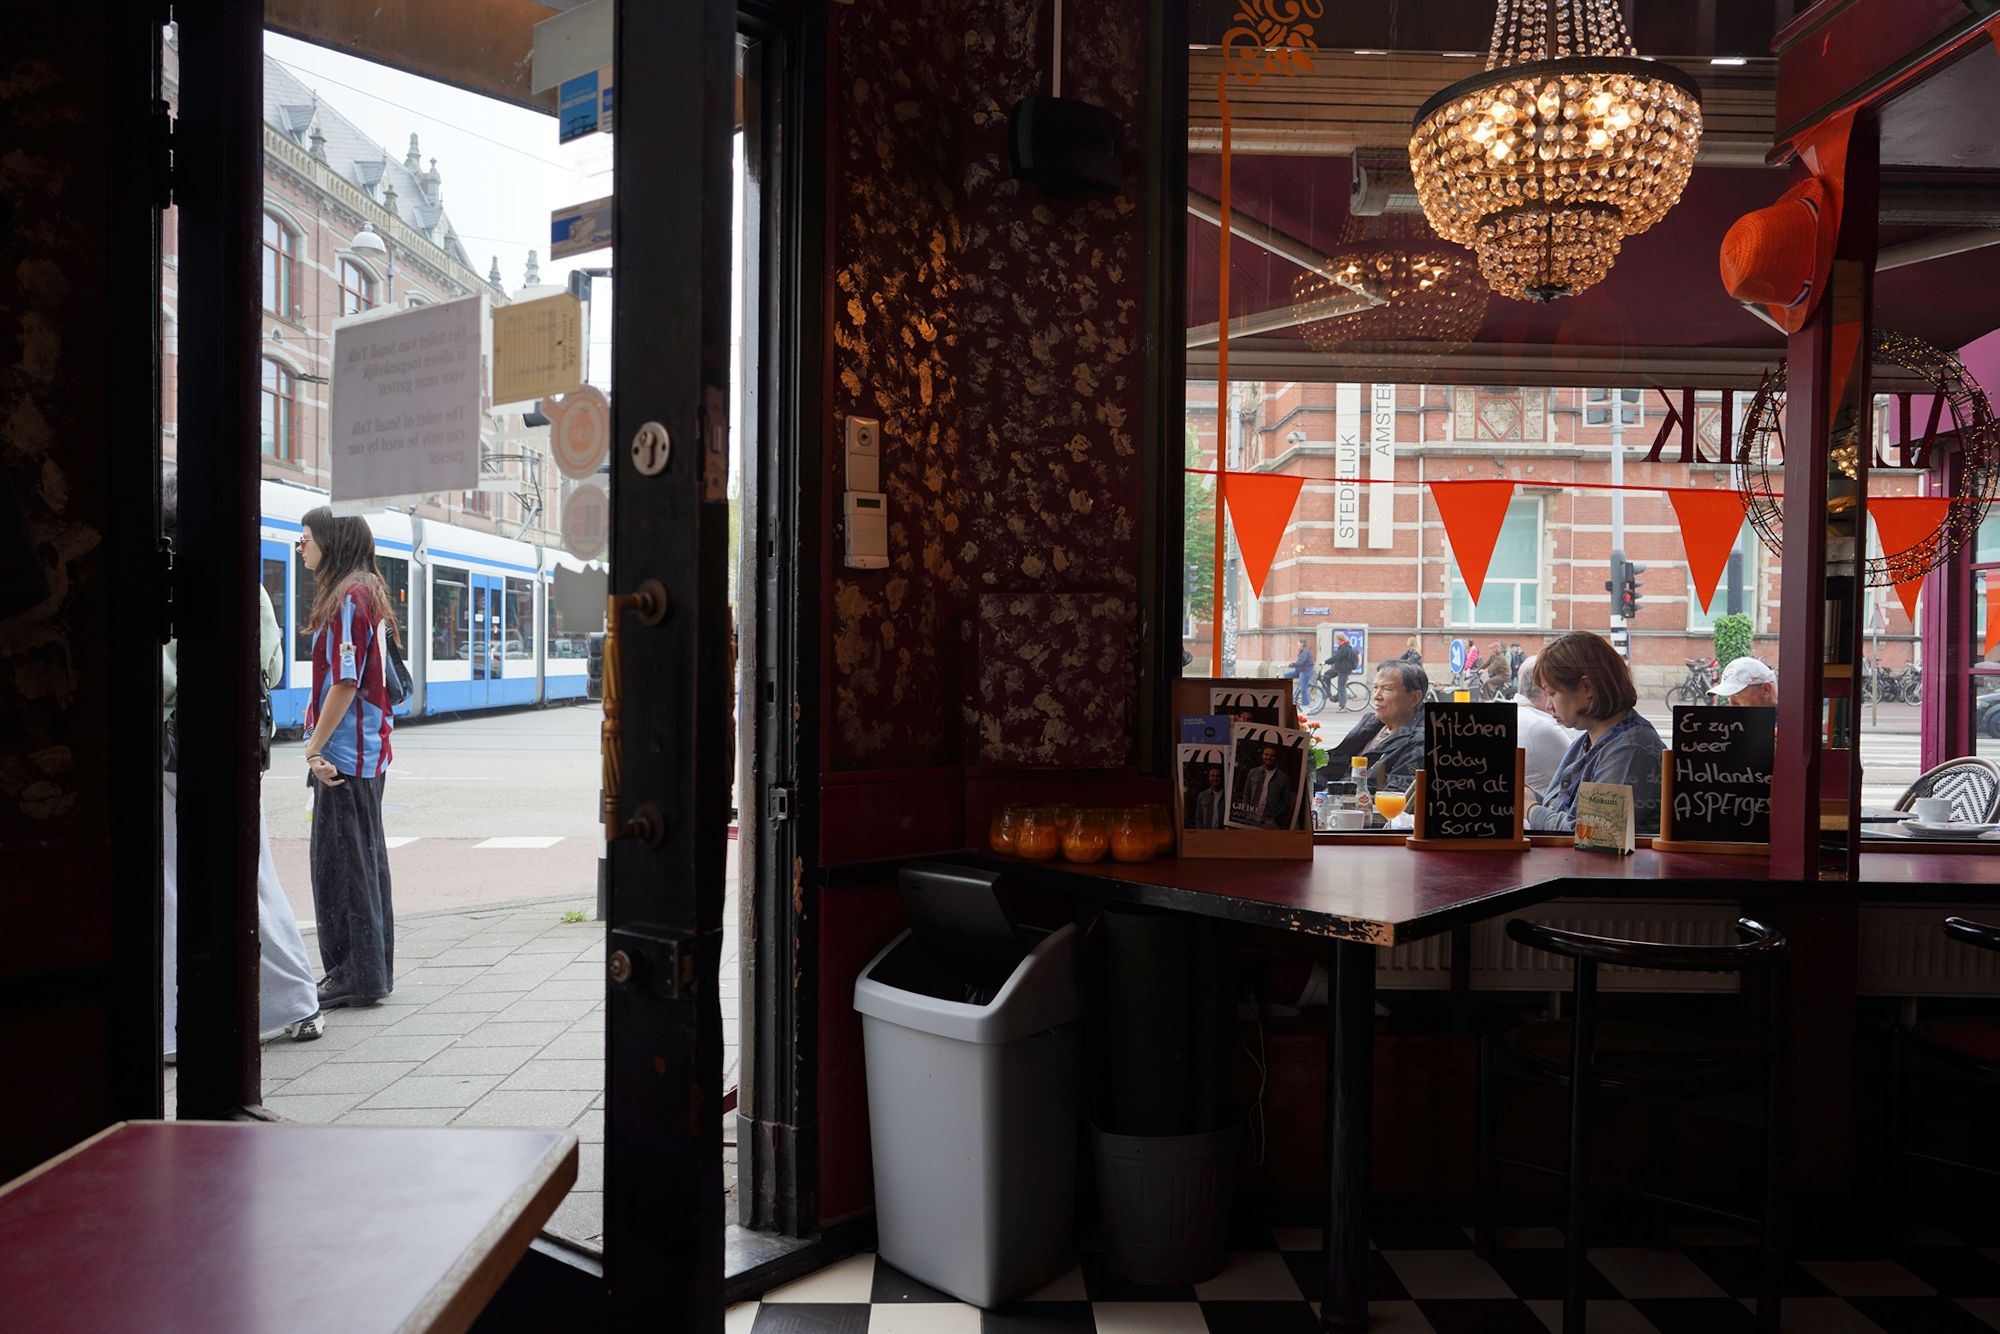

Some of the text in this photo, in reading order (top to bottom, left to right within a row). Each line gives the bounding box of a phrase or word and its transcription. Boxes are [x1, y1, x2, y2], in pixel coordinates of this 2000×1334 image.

[1339, 434, 1356, 539] STEDELIJK
[1430, 711, 1507, 744] Kitchen
[1680, 712, 1702, 733] Er
[1681, 741, 1732, 753] weer
[1427, 745, 1488, 775] Today
[1483, 774, 1509, 793] at
[1429, 801, 1482, 818] 1200
